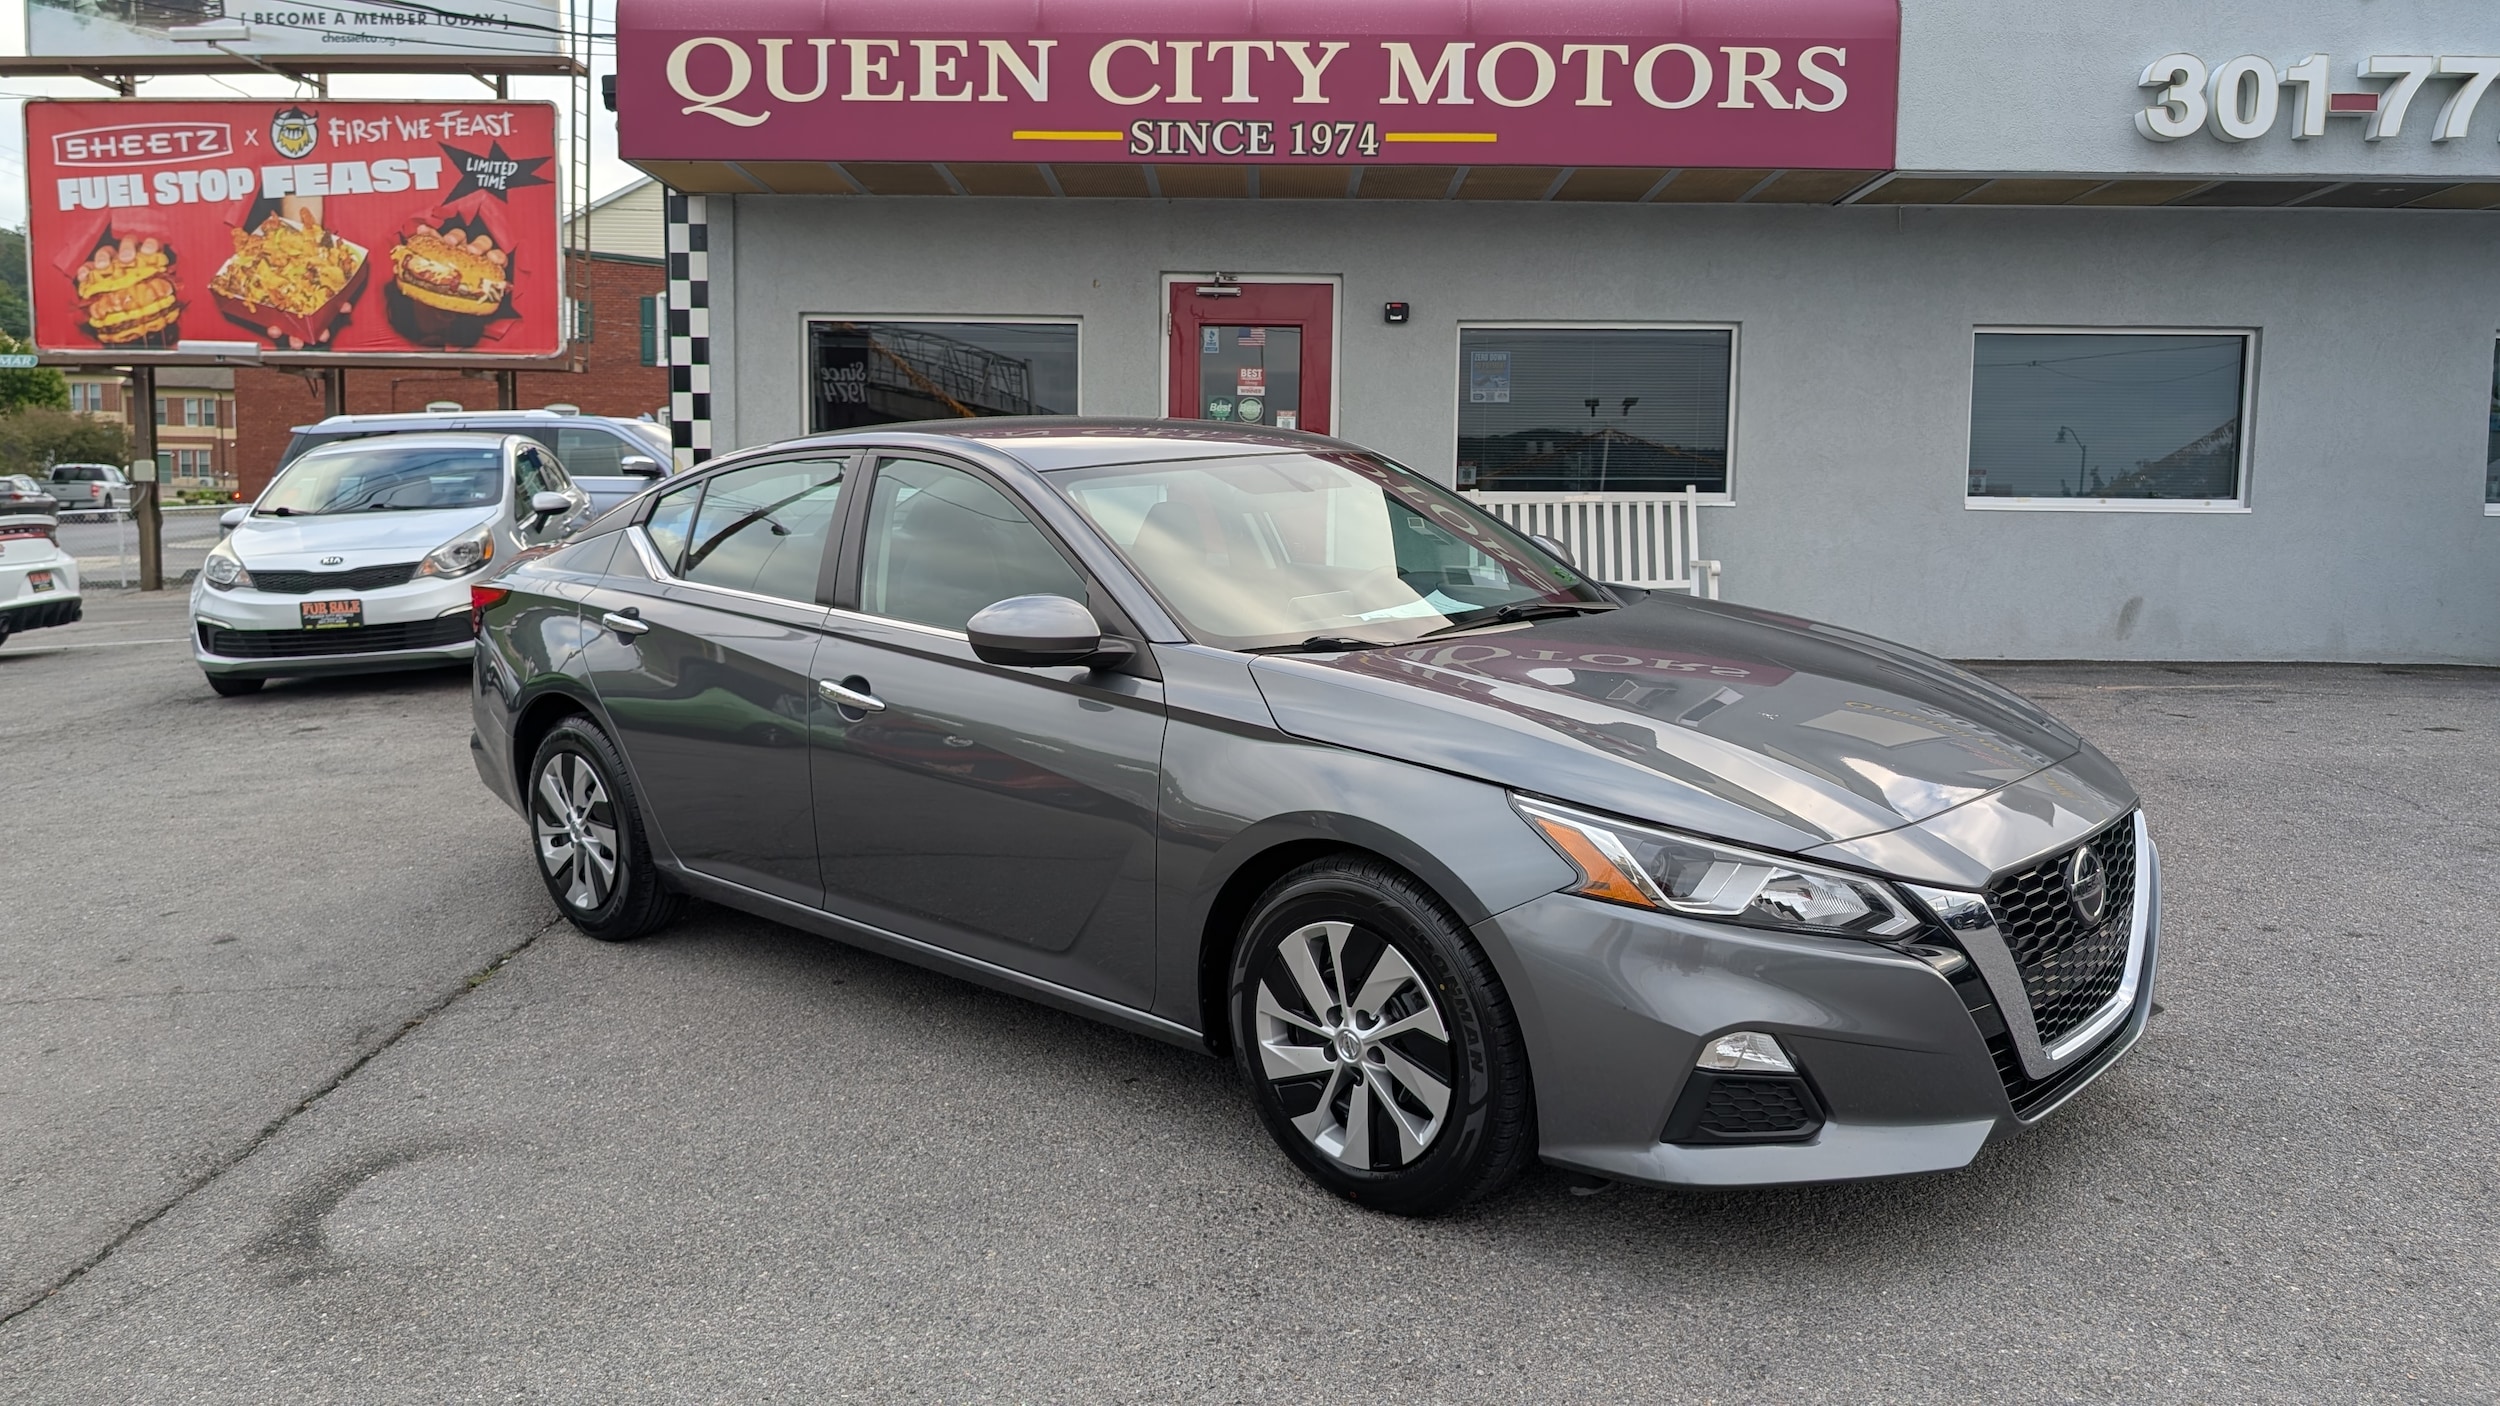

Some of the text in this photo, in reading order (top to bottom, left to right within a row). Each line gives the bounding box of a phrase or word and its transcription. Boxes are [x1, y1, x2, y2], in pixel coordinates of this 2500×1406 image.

[254, 12, 326, 25] BECOME
[333, 12, 347, 25] A
[354, 12, 427, 25] MEMBER
[435, 12, 495, 26] TODAY
[666, 37, 1848, 127] QUEEN CITY MOTORS
[2134, 53, 2500, 142] 301-77
[328, 110, 514, 147] FIRST WE FEAST
[1129, 120, 1380, 156] SINCE 1974
[66, 130, 219, 160] SHEETZ
[466, 157, 518, 177] LIMITED
[57, 156, 442, 212] FUEL STOP FEAST
[476, 174, 506, 190] TIME
[1240, 368, 1263, 378] BEST
[1209, 402, 1232, 412] Best
[322, 556, 342, 565] KIA
[329, 600, 360, 614] SALE
